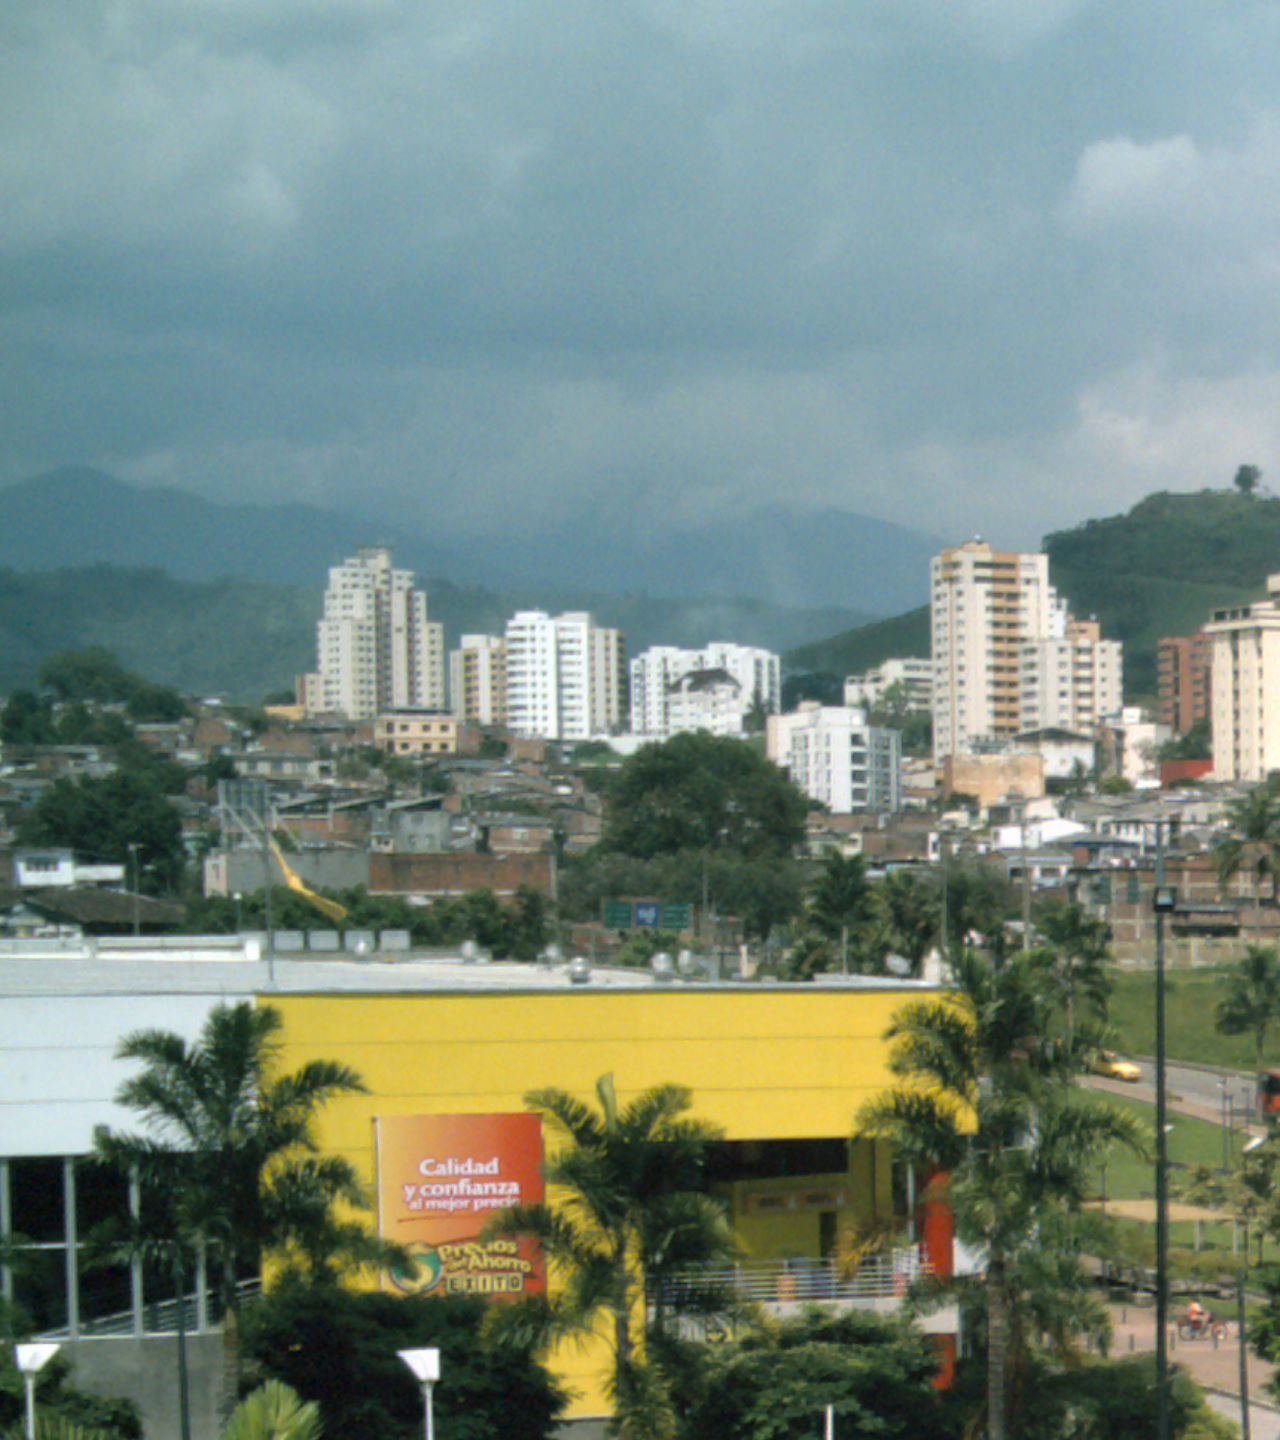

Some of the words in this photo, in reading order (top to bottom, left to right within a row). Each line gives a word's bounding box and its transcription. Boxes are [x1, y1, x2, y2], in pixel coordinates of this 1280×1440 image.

[419, 1157, 499, 1176] Calidad
[402, 1184, 416, 1203] y
[420, 1178, 519, 1197] confianza
[409, 1198, 422, 1210] al
[425, 1197, 469, 1212] mejor
[468, 1251, 531, 1273] Ahorro
